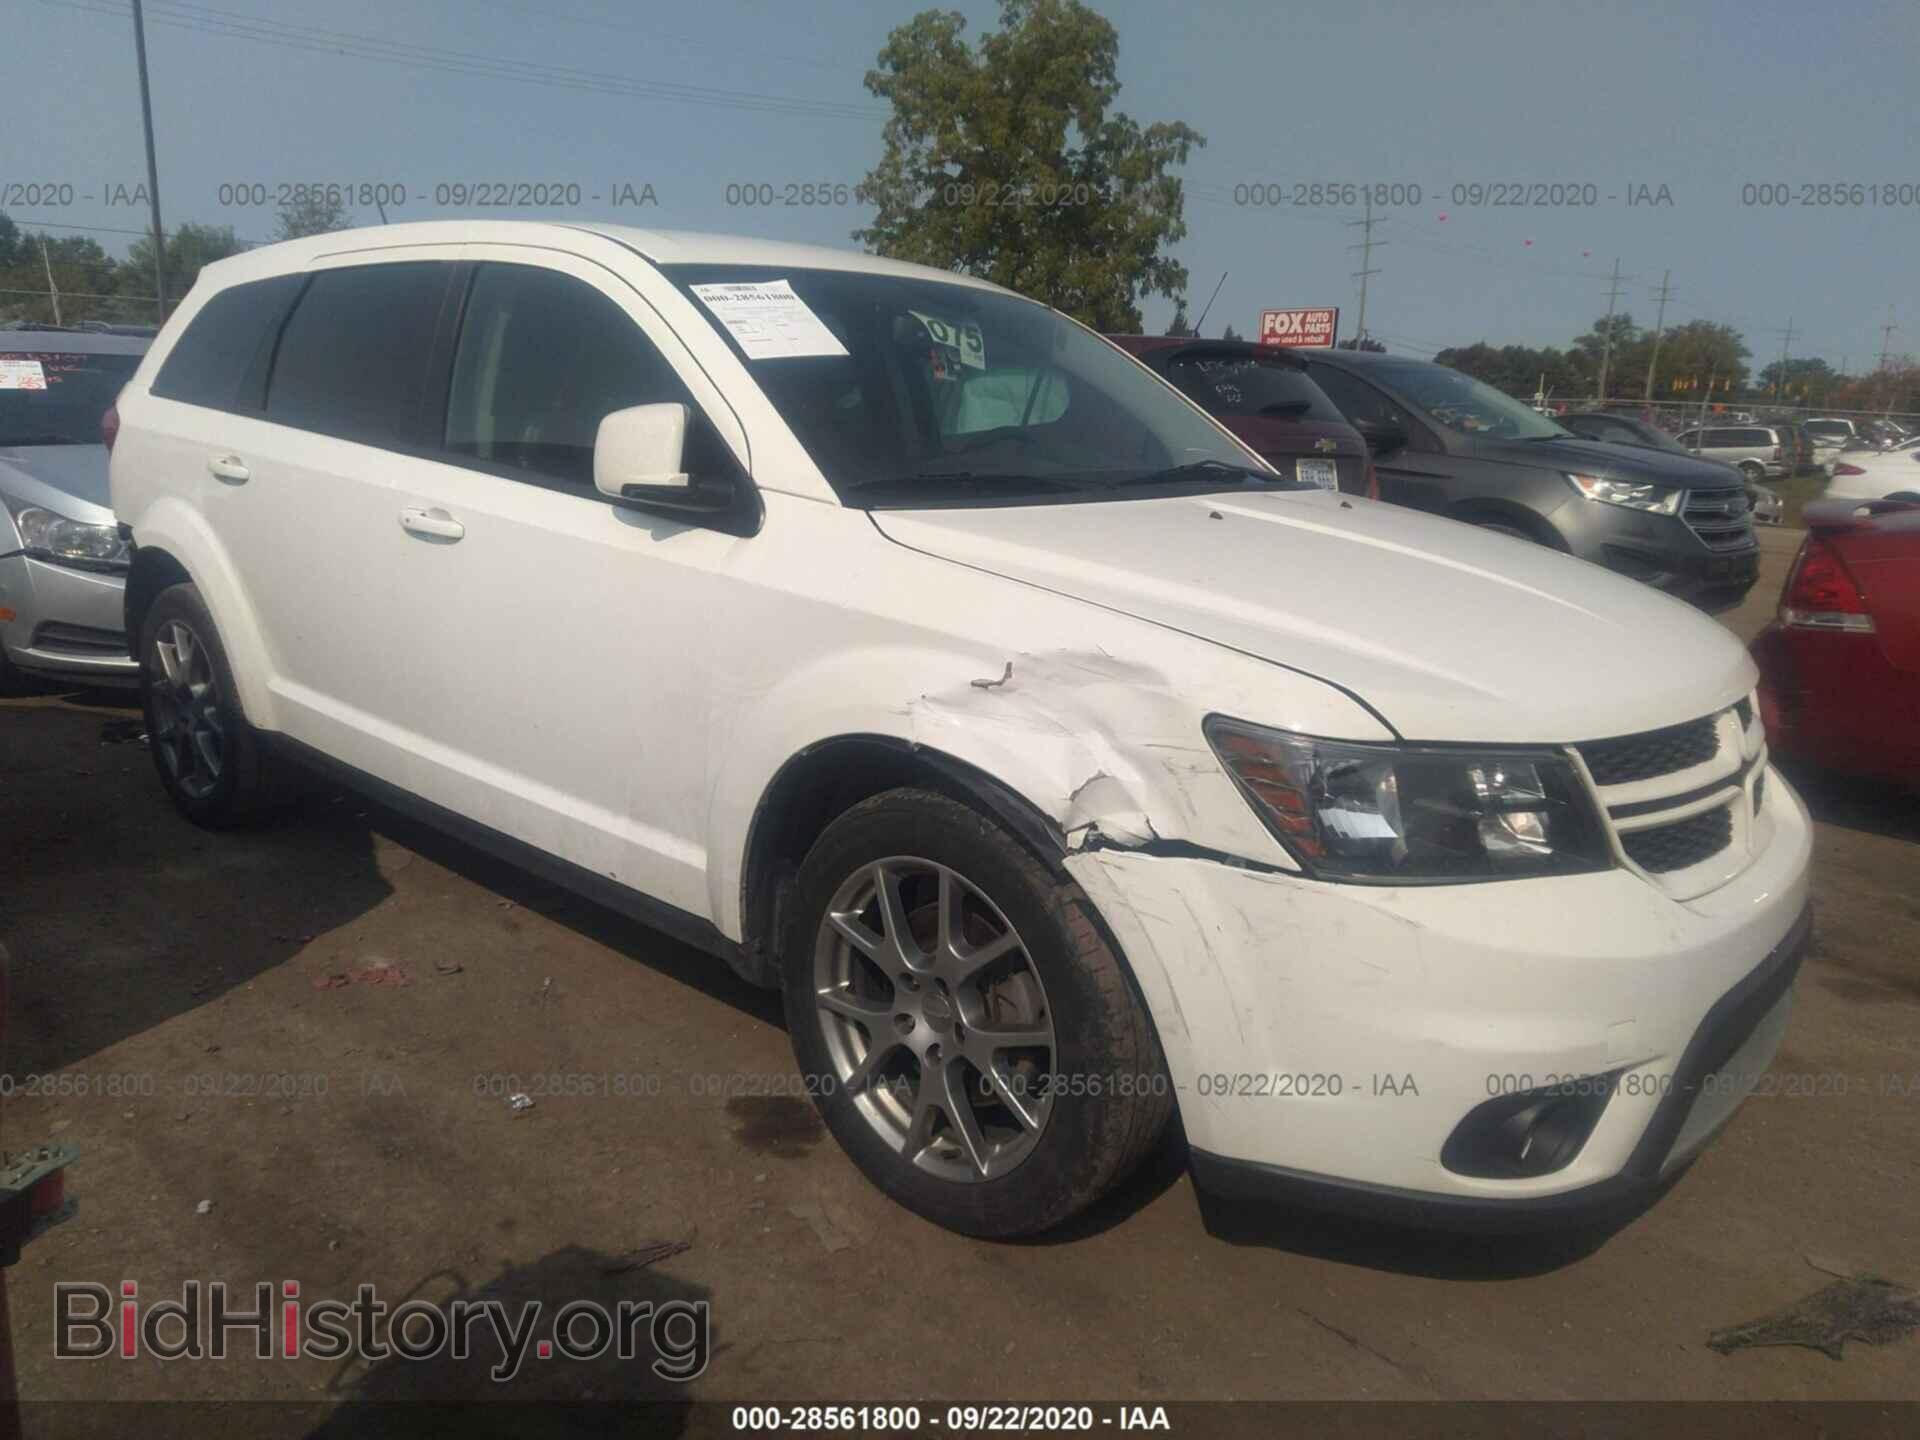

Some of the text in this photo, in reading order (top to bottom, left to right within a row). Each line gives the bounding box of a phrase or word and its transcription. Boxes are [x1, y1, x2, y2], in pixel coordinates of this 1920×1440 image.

[1306, 312, 1330, 322] AUTO
[1264, 312, 1304, 334] FOX
[1305, 322, 1331, 333] PARTS
